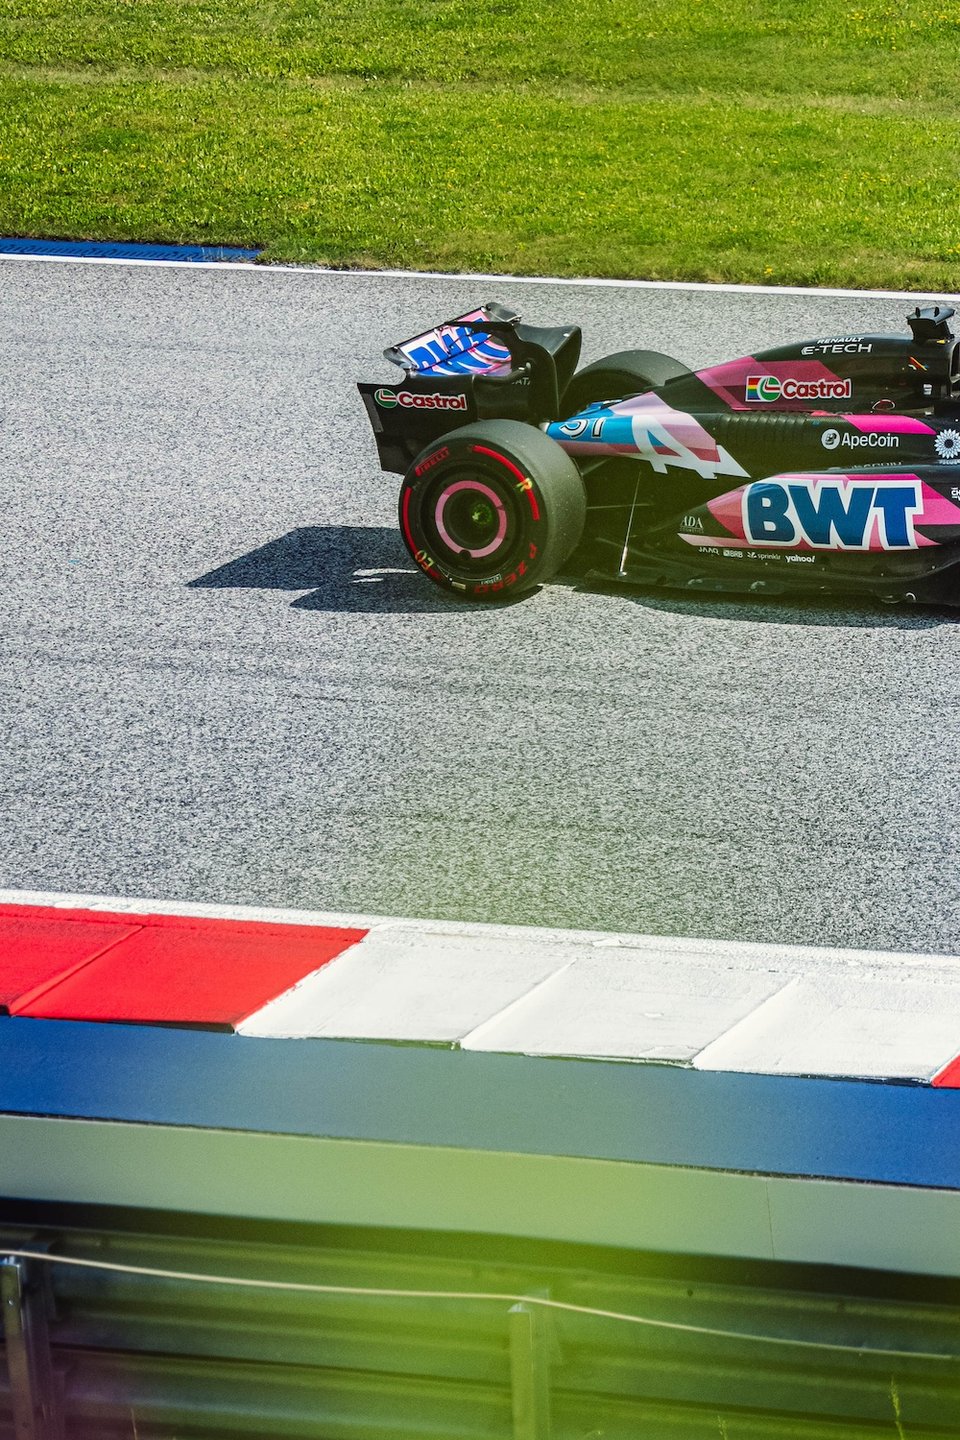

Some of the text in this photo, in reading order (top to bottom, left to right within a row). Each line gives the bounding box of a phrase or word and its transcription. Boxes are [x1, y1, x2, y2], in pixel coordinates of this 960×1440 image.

[817, 336, 865, 344] RENAULT
[801, 343, 873, 355] E-TECH
[781, 378, 851, 399] Castrol
[398, 393, 467, 410] Castrol
[841, 433, 900, 449] ApeCoin
[680, 515, 704, 528] ADA
[744, 481, 920, 549] BWT
[785, 555, 816, 563] yahoo!
